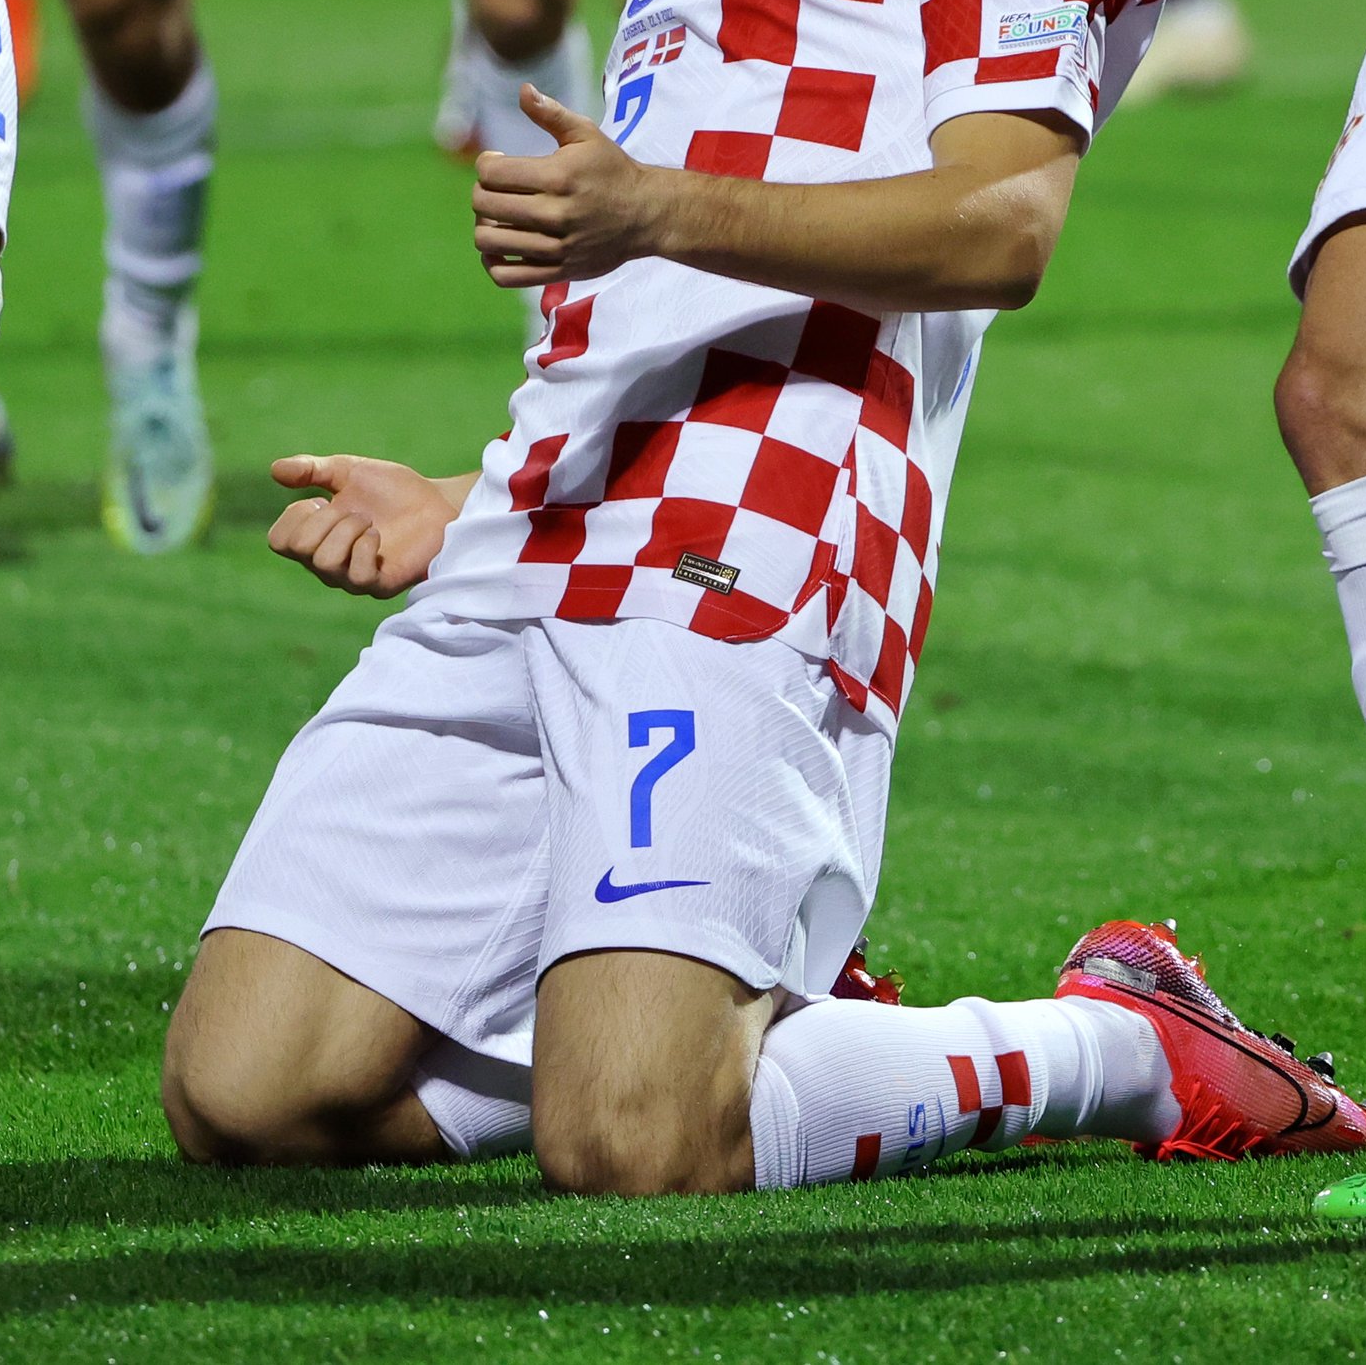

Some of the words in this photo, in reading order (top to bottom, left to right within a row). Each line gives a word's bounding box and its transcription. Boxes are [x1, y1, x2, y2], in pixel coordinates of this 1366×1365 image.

[998, 14, 1085, 39] FOUNDA
[1000, 13, 1032, 24] UEFA
[614, 73, 655, 146] 7
[628, 709, 696, 848] 7
